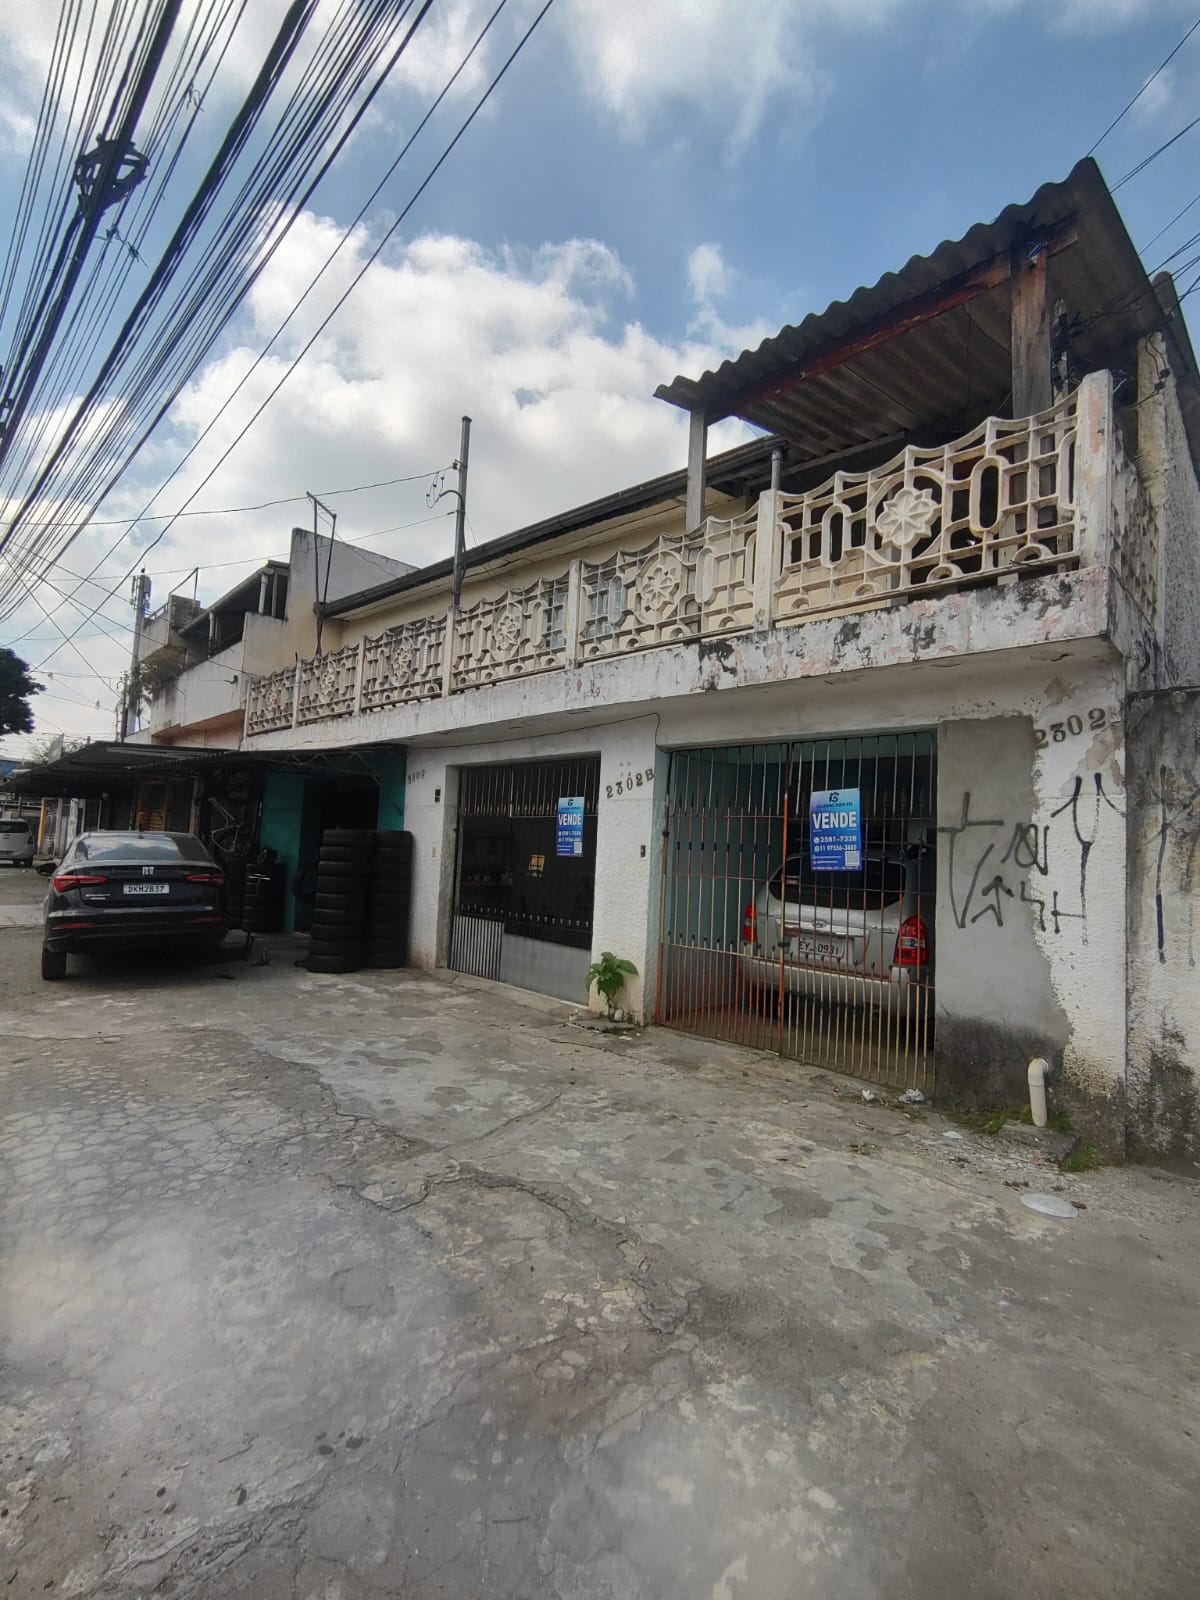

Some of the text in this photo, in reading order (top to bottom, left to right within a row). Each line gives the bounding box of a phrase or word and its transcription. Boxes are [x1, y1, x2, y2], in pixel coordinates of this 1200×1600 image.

[1034, 707, 1106, 751] 2302
[606, 768, 654, 799] 2302B
[558, 813, 582, 826] VENDE
[813, 811, 857, 829] VENDE
